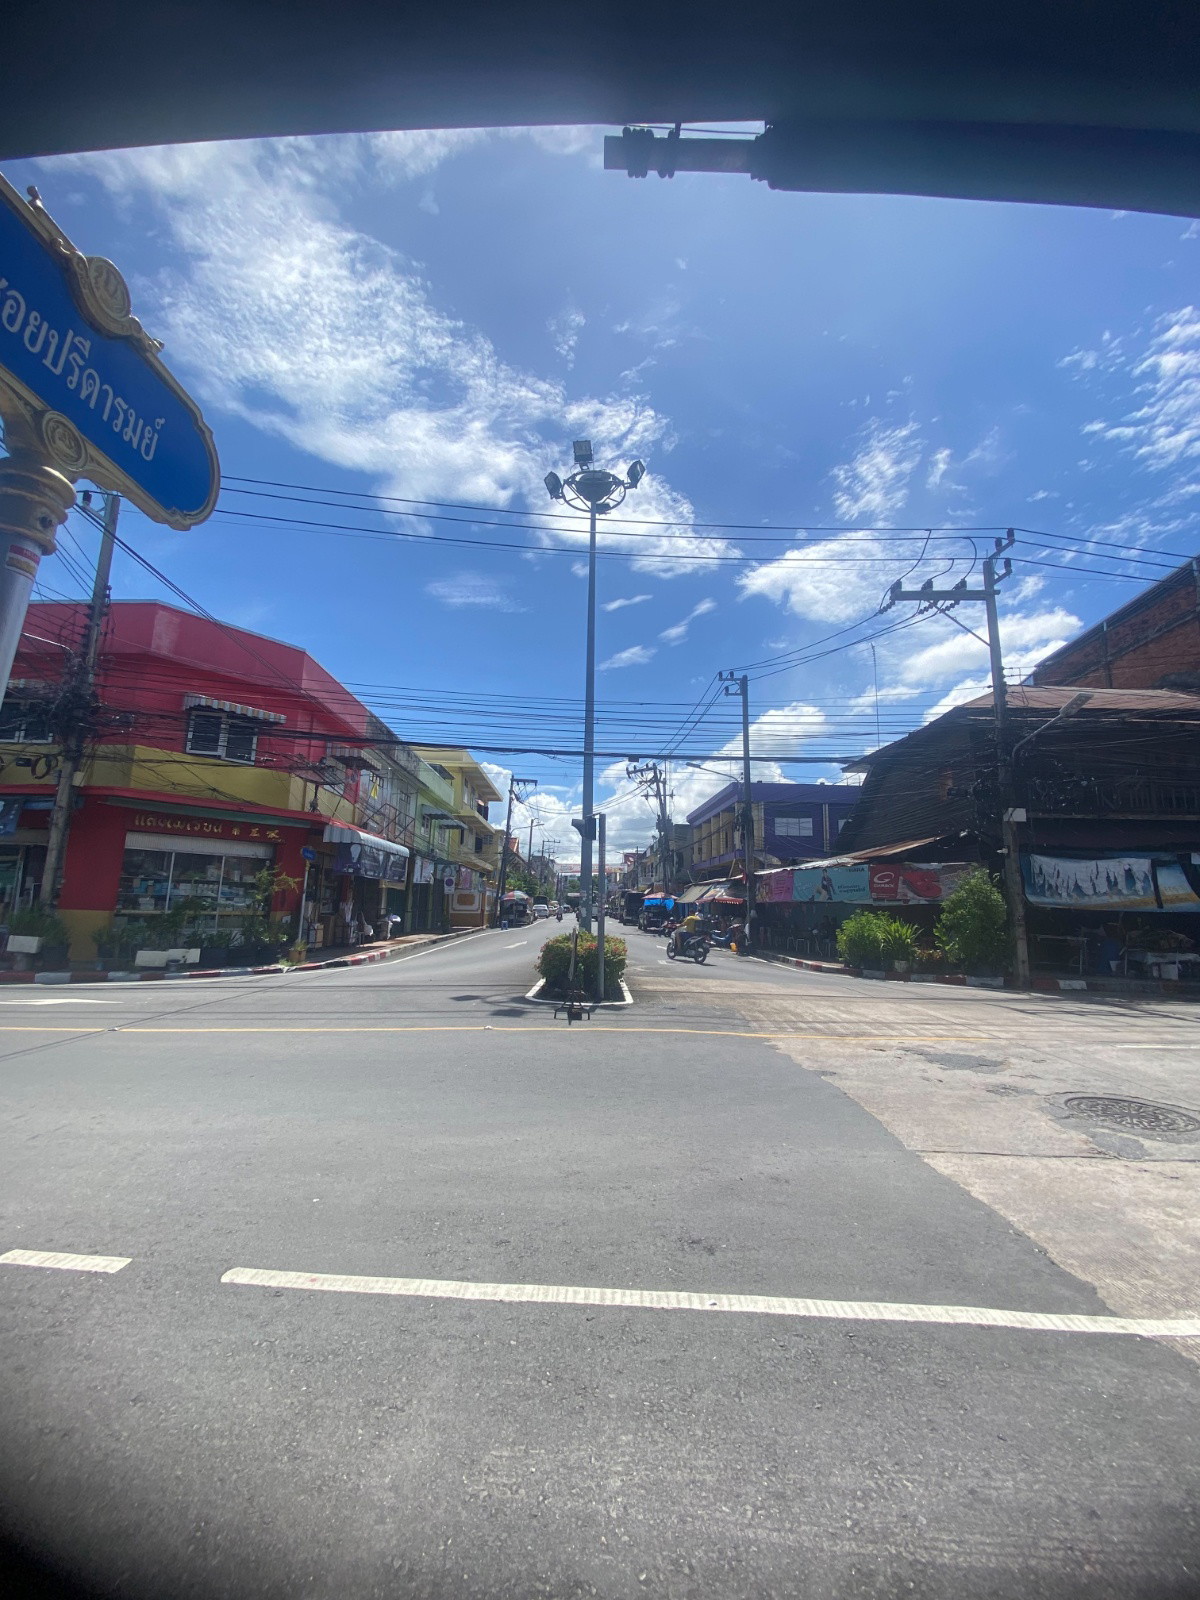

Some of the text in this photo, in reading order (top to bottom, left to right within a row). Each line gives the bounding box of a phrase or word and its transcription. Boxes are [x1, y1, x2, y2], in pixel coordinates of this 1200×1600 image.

[0, 277, 165, 461] อยปรีดารมย์
